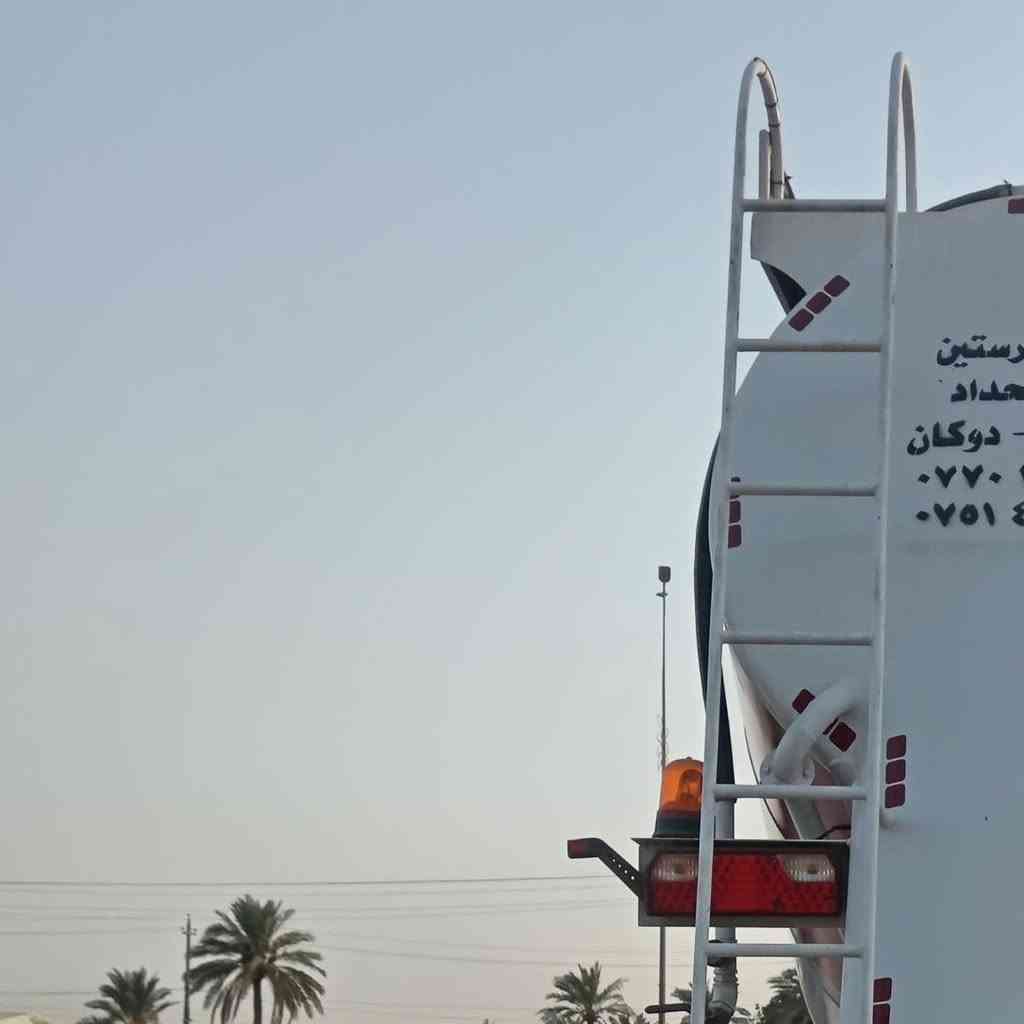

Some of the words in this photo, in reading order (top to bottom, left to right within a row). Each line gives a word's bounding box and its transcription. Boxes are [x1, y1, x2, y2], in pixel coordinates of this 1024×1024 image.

[906, 420, 1001, 456] دوكان
[917, 465, 1002, 489] ٠٧٧٠
[915, 502, 996, 528] ٠٧٥١
